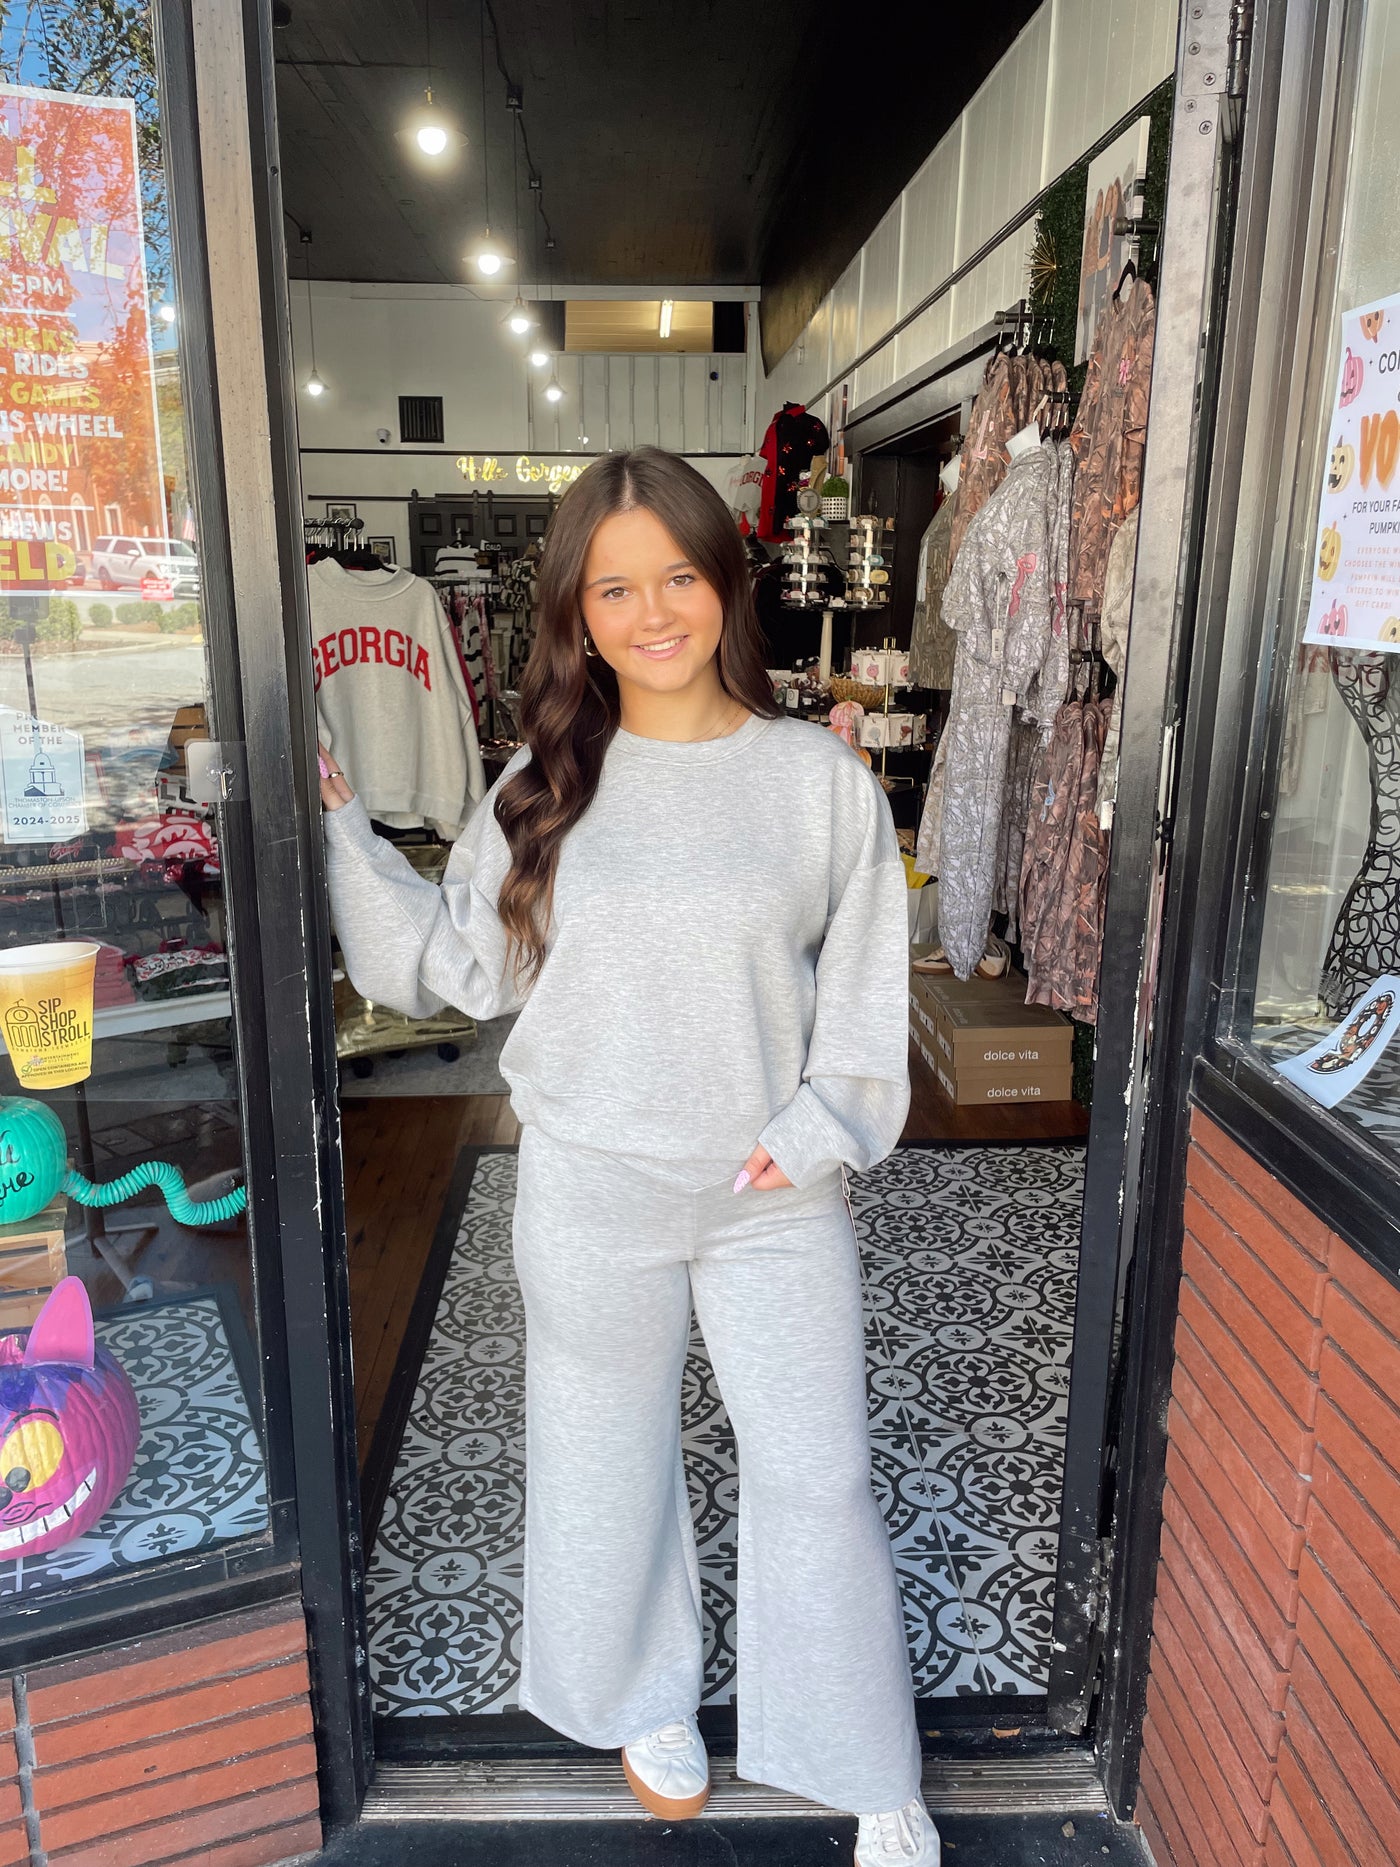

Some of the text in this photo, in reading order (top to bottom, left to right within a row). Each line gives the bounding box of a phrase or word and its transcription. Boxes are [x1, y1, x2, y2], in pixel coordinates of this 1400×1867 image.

[11, 273, 64, 297] 5PM
[13, 352, 89, 379] RIDES
[1379, 350, 1400, 374] CO
[10, 381, 100, 409] GAMES
[33, 411, 123, 438] WHEEL
[1359, 410, 1400, 493] VO
[1352, 501, 1368, 513] FOR
[1369, 500, 1391, 512] YOUR
[13, 723, 65, 734] MEMBER
[18, 736, 63, 746] OF THE
[13, 815, 80, 826] 2024-2025
[38, 997, 62, 1015] SIP
[40, 1009, 77, 1031] SHOP
[41, 1020, 90, 1047] STROLL
[983, 1050, 1039, 1061] dolce vita
[987, 1086, 1041, 1098] dolce vita
